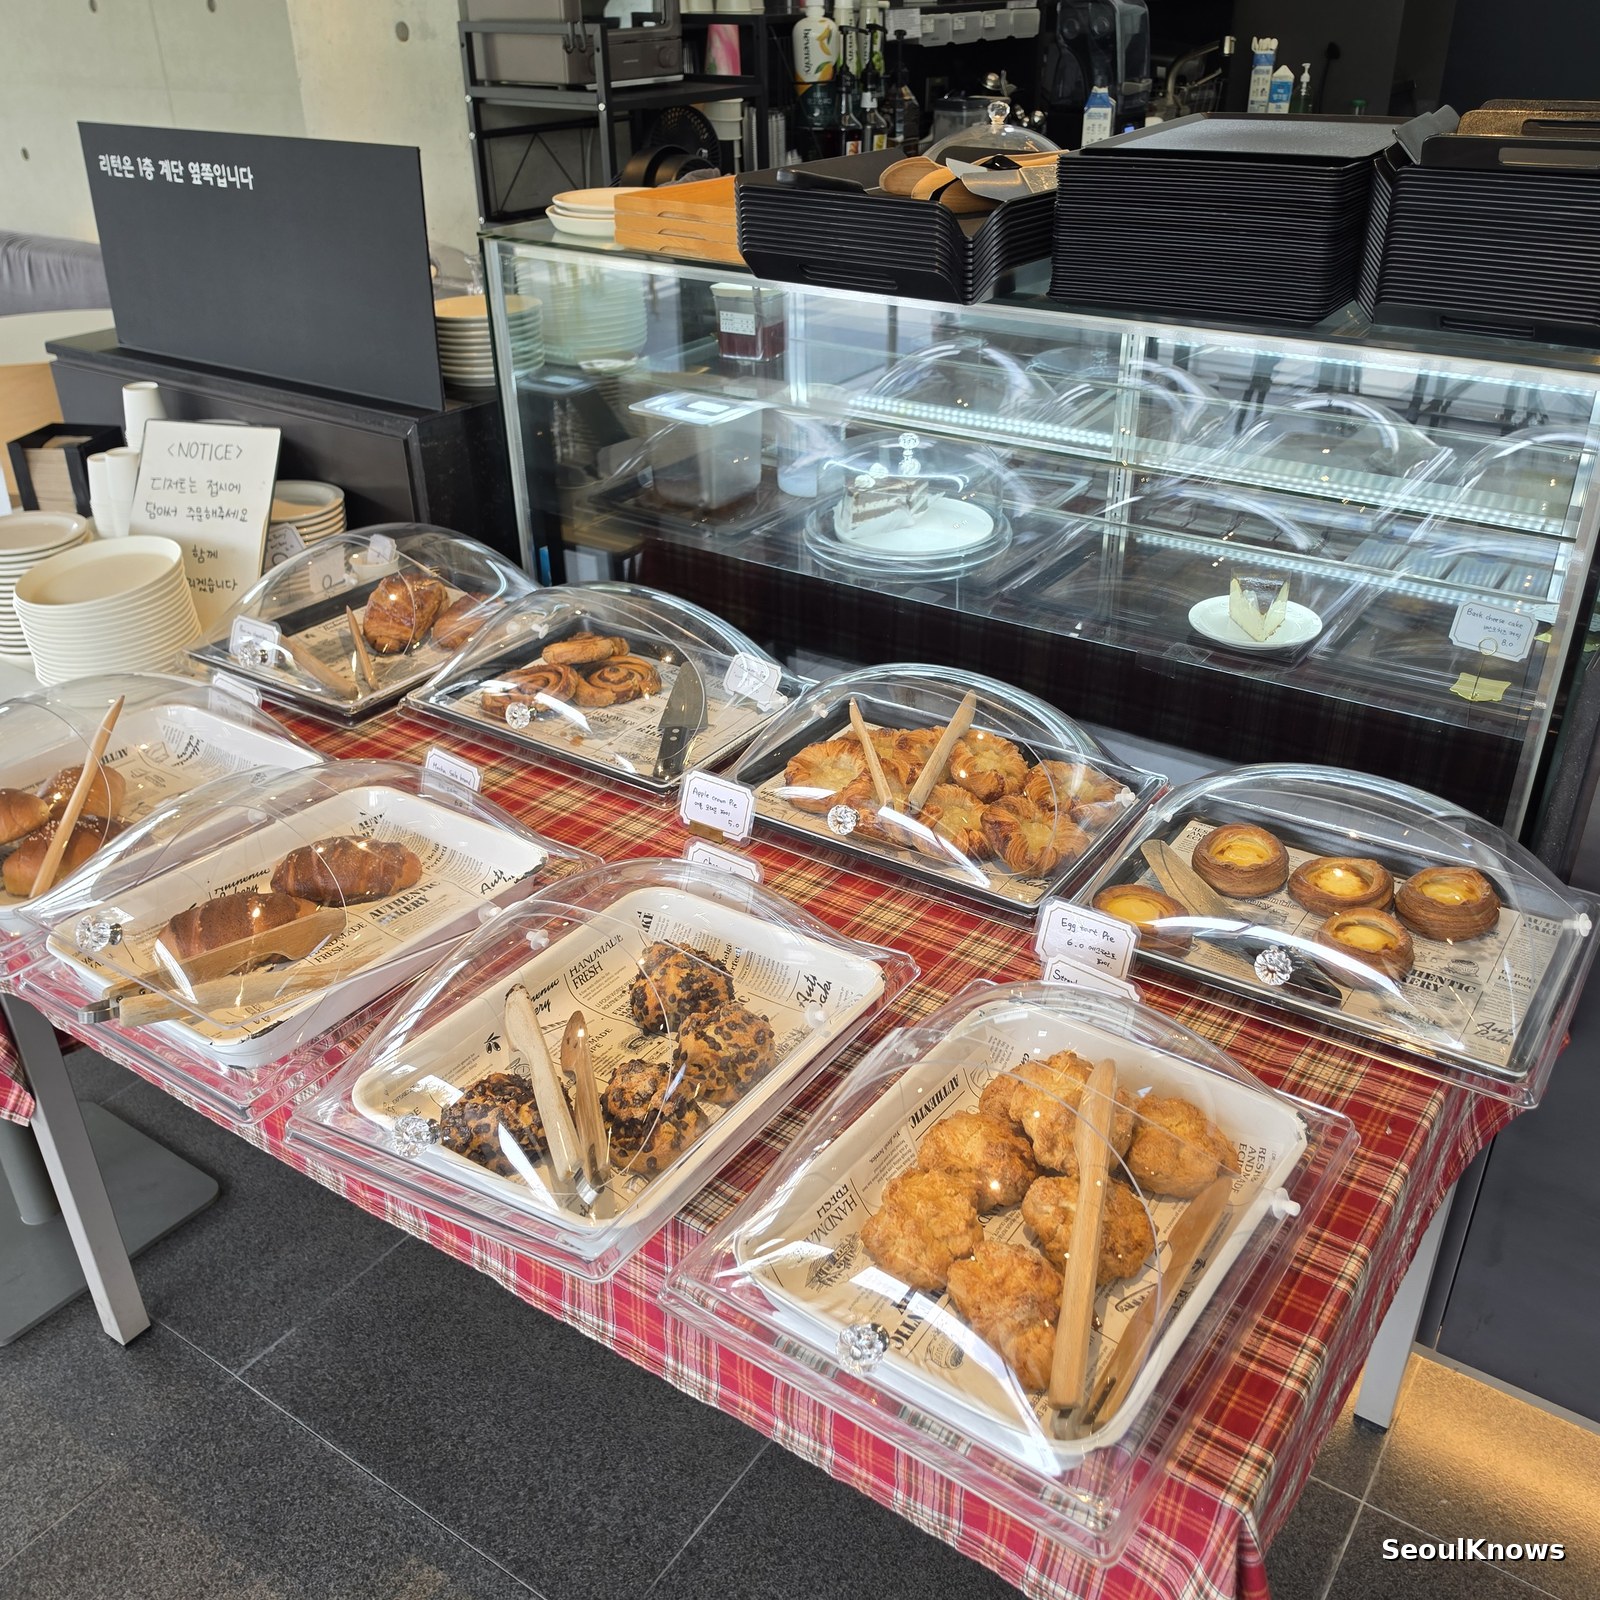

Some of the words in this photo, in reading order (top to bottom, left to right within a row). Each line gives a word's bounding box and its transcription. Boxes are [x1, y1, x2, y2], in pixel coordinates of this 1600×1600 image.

[98, 153, 135, 179] 리턴은
[136, 156, 155, 181] 1층
[158, 159, 184, 184] 계단
[188, 161, 254, 191] 옆쪽입니다
[150, 477, 198, 494] 디저트는
[206, 479, 242, 498] 접시에
[145, 502, 178, 520] 담아서
[185, 506, 248, 523] 주문해주세요
[191, 544, 218, 564] 함께
[692, 787, 710, 800] Apple
[728, 799, 738, 809] Pie
[369, 881, 440, 919] AUTHENTIC
[310, 922, 368, 957] NDMADE
[1061, 917, 1076, 933] Egg
[1102, 930, 1115, 943] Pie
[1066, 938, 1084, 949] 6.0
[572, 960, 603, 990] FRESH
[908, 1074, 960, 1129] AUTHENTIC
